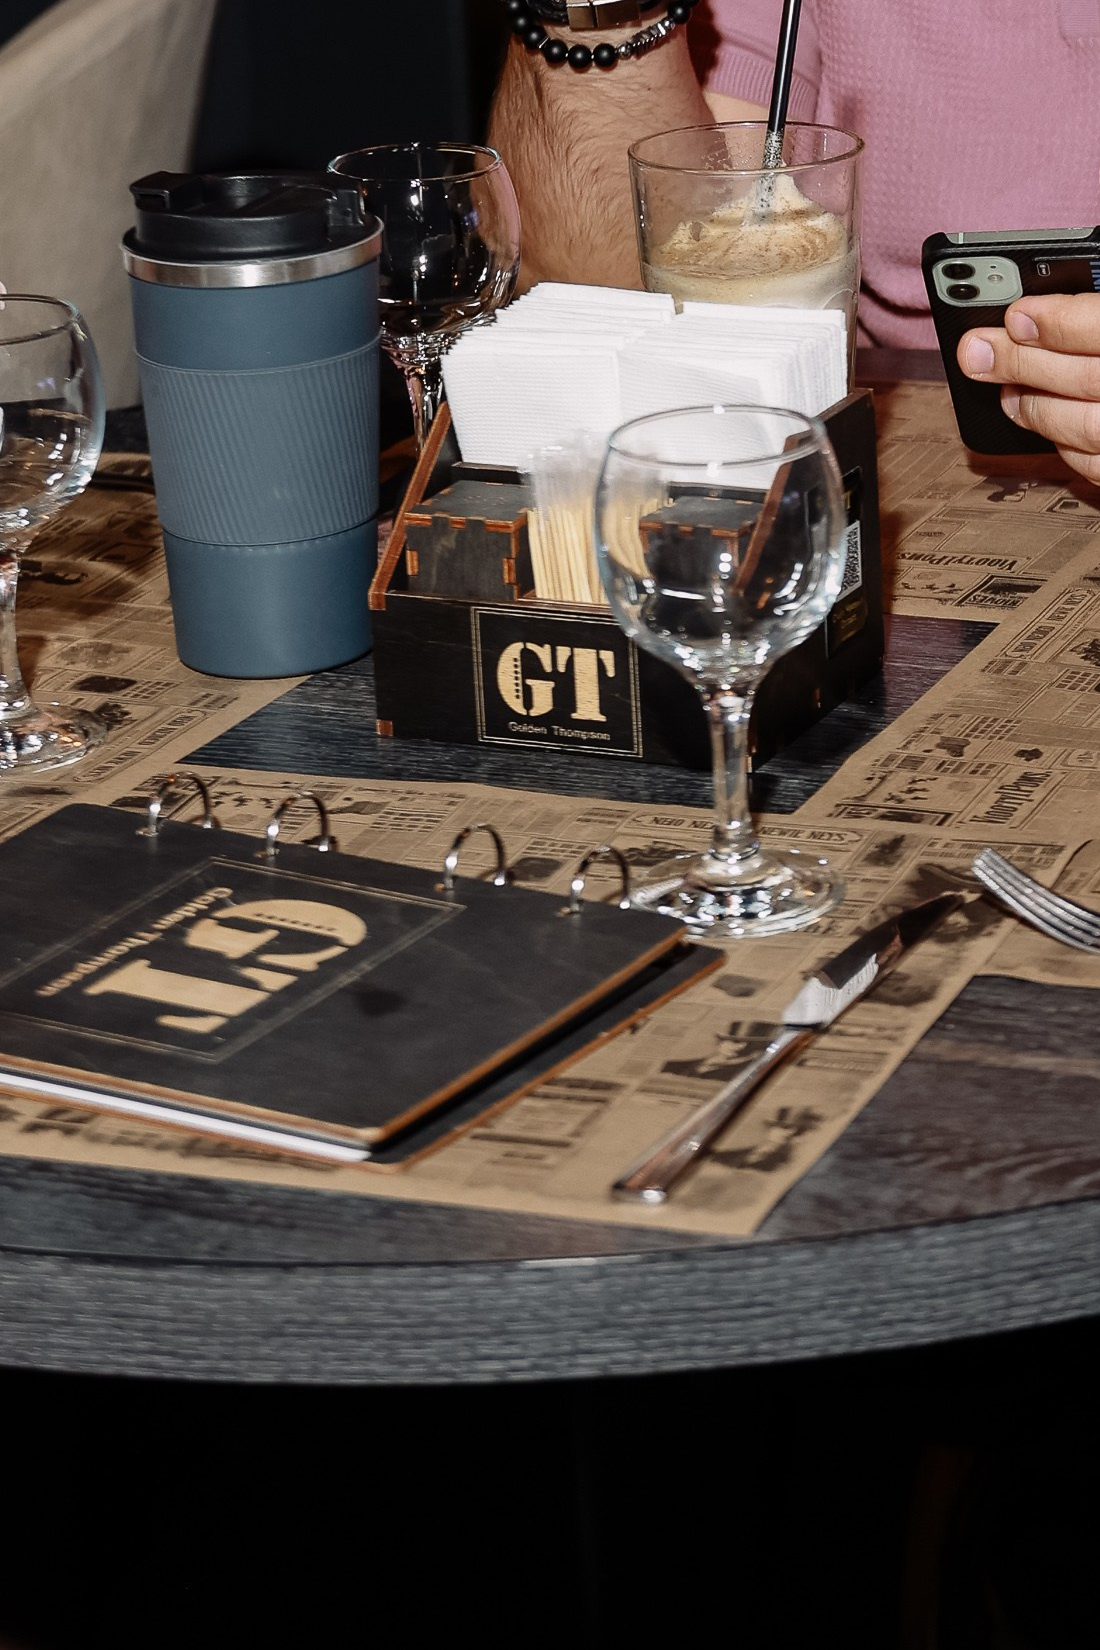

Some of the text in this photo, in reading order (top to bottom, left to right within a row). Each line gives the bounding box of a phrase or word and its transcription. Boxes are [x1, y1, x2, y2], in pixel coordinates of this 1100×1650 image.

[496, 641, 616, 722] GT
[508, 721, 611, 741] Golden Thompson
[35, 886, 233, 997] Golden Thompson
[83, 899, 368, 1034] GT
